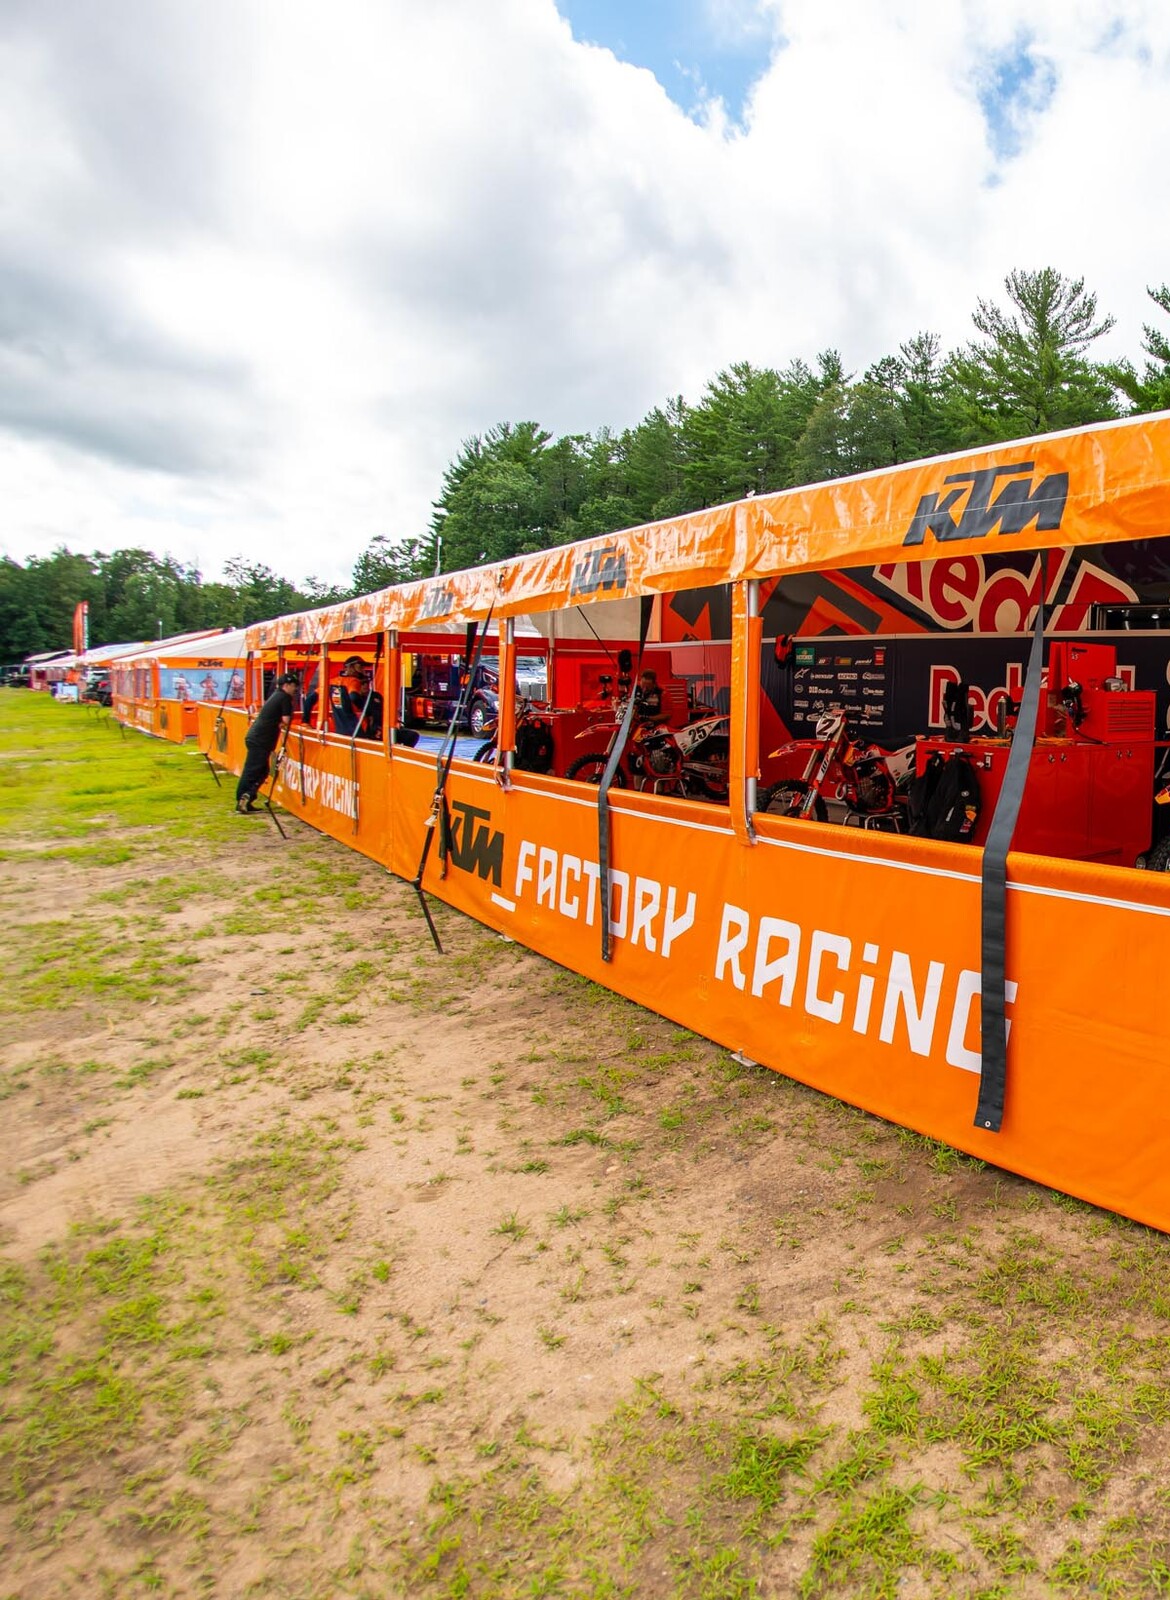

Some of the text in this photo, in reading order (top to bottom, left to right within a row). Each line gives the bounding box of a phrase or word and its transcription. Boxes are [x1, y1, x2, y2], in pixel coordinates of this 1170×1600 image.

[903, 461, 1069, 547] KTM
[570, 547, 628, 597] KTM
[688, 725, 707, 745] 25
[817, 717, 836, 736] 2
[440, 800, 506, 889] KTM
[514, 839, 698, 959] FACTORY
